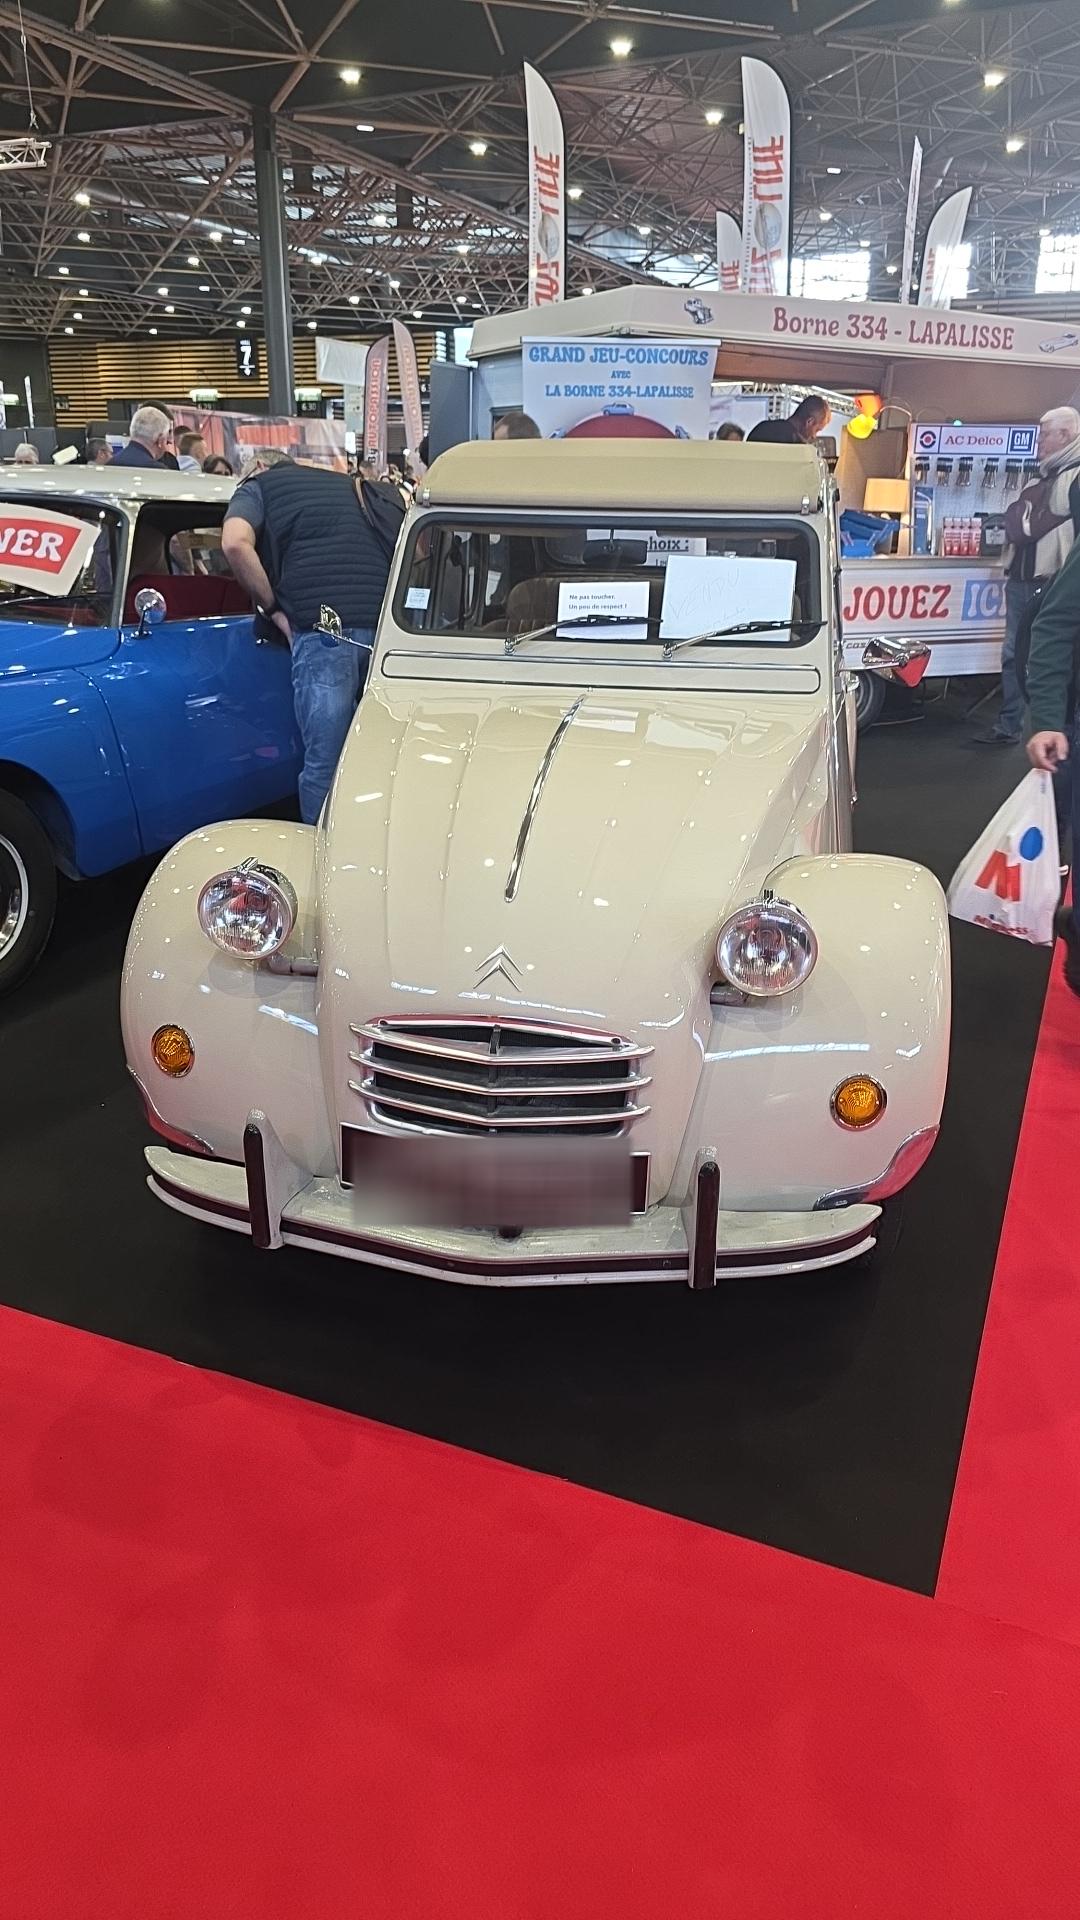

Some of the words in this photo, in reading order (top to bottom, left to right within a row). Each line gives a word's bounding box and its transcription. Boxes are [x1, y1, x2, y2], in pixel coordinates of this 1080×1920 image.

[773, 306, 840, 337] Borne
[846, 313, 888, 341] 334
[908, 319, 1015, 351] LAPALISSE
[528, 346, 586, 363] GRAND
[590, 346, 709, 366] JEU-CONCOURS
[611, 370, 632, 379] AVEC
[545, 384, 561, 397] LA
[564, 384, 605, 398] BORNE
[608, 385, 694, 399] 334-LAPALISSE
[945, 435, 965, 446] AC
[968, 435, 1004, 446] Delco
[1014, 432, 1030, 446] GM
[843, 584, 952, 621] JOUEZ
